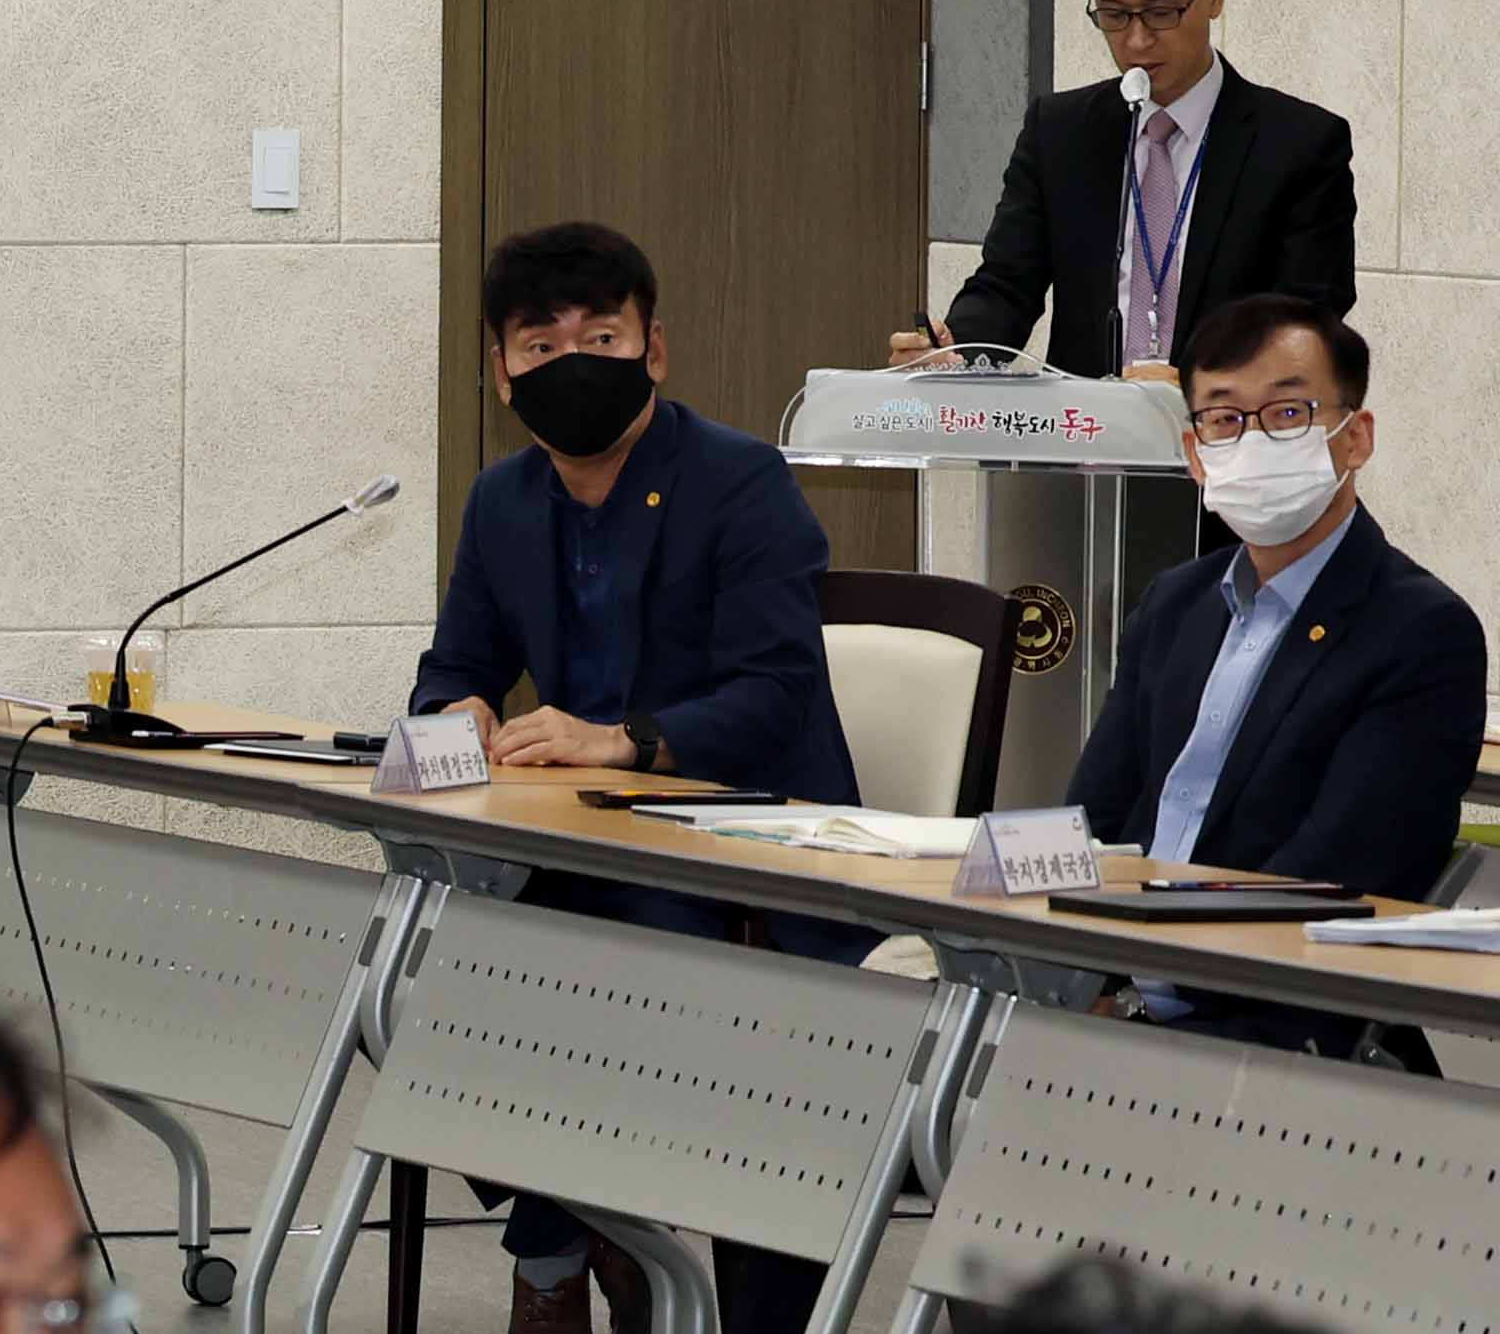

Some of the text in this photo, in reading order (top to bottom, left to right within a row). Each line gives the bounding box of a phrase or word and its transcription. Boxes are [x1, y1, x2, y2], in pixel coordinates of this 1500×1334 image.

[938, 406, 986, 434] 활기찬
[991, 410, 1055, 437] 행복도시
[1058, 408, 1105, 441] 동구
